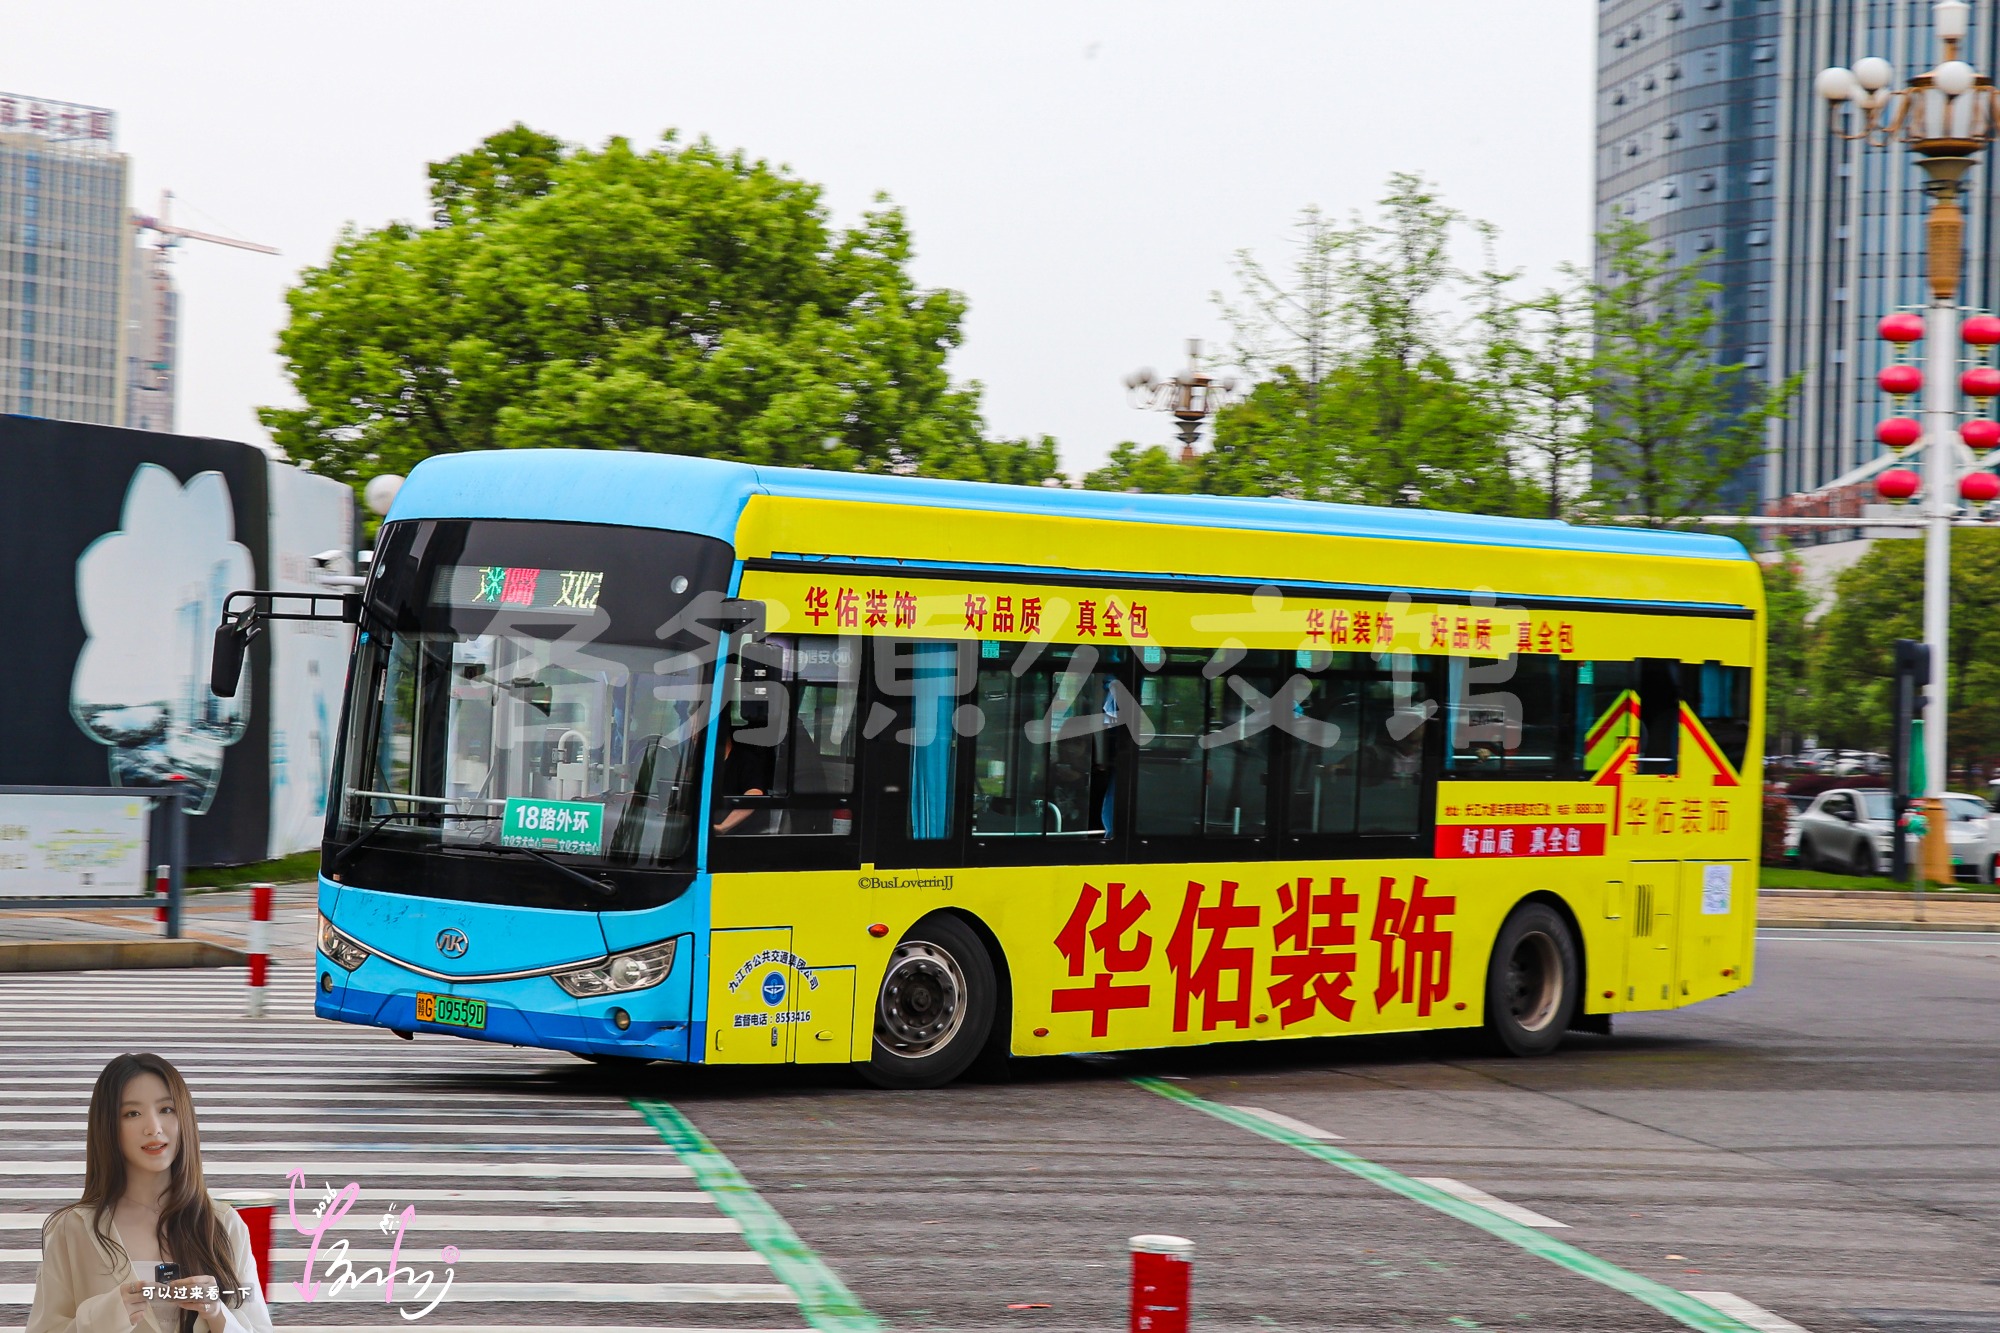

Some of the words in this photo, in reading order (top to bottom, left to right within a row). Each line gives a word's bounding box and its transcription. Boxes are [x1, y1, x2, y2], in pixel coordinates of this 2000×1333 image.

[805, 586, 918, 630] 华佑装饰
[964, 593, 1042, 635] 好品质
[1076, 599, 1149, 638] 真全包
[1306, 608, 1394, 646] 华佑装饰
[1431, 614, 1492, 650] 好品质
[1517, 621, 1574, 654] 真全包
[516, 805, 590, 833] 18路外环
[1626, 797, 1729, 835] 华佑装饰
[1462, 827, 1515, 854] 好品质
[1529, 826, 1582, 853] 真全包
[728, 949, 820, 993] 九江市公共交通集团公司
[1051, 875, 1456, 1037] 华佑装饰
